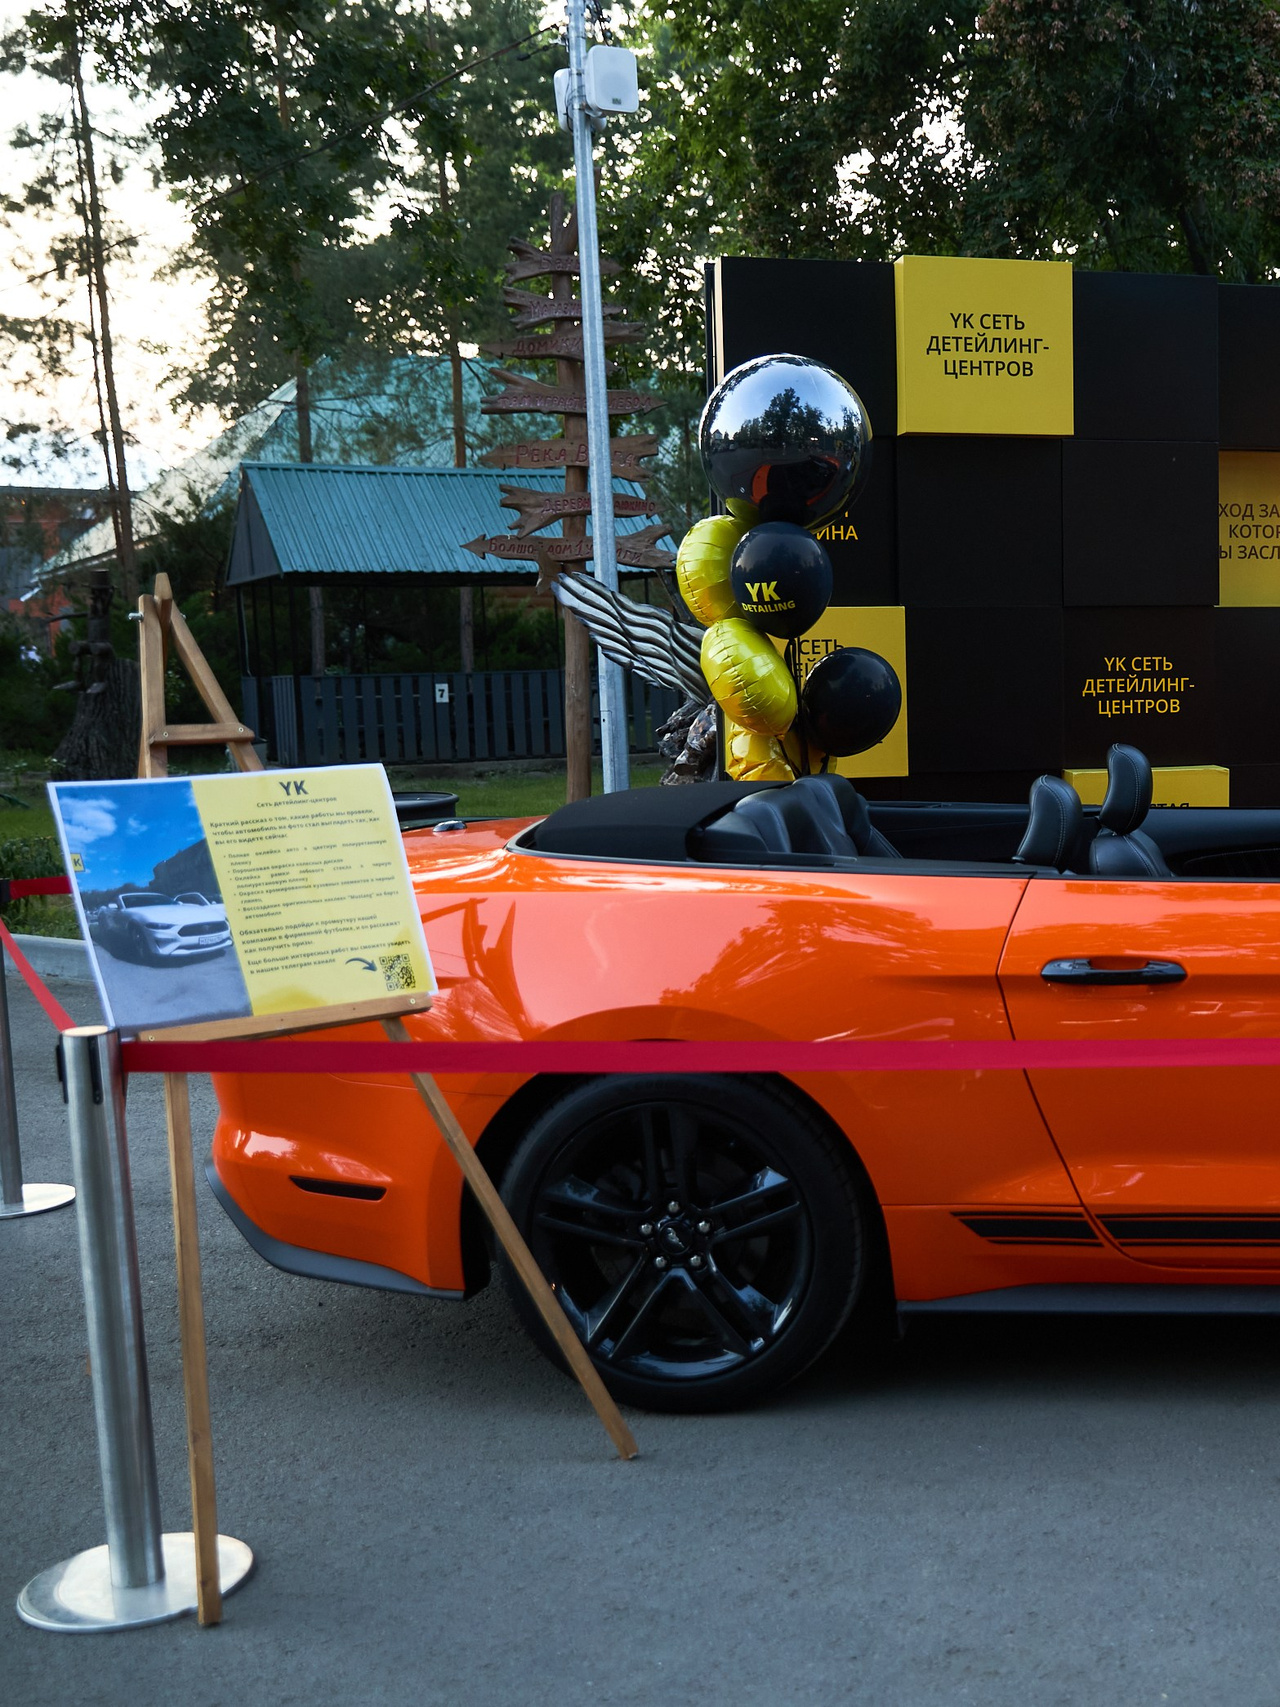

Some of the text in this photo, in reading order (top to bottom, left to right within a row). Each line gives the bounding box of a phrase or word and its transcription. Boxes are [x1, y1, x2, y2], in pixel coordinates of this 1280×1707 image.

[950, 312, 1025, 330] YK СЕТЬ
[926, 332, 1049, 355] ДЕТЕЙЛИНГ-
[944, 359, 1034, 379] ЦЕНТРОВ
[541, 498, 591, 513] ДЕРЕВН
[1218, 503, 1254, 521] ХОД
[1259, 504, 1280, 518] ЗА
[1218, 545, 1232, 559] Ы
[744, 580, 781, 602] YK
[741, 600, 796, 613] DETAILING
[1104, 656, 1173, 672] YK СЕТЬ
[1082, 674, 1195, 697] ДЕТЕЙЛИНГ-
[438, 688, 445, 699] 7
[1098, 699, 1181, 718] ЦЕНТРОВ
[278, 780, 309, 796] YK
[240, 818, 267, 826] рассказ
[235, 826, 277, 834] автомобиль
[239, 926, 284, 936] Обязательно
[241, 936, 277, 945] компании
[284, 930, 322, 939] фирменной
[281, 962, 312, 970] телеграм
